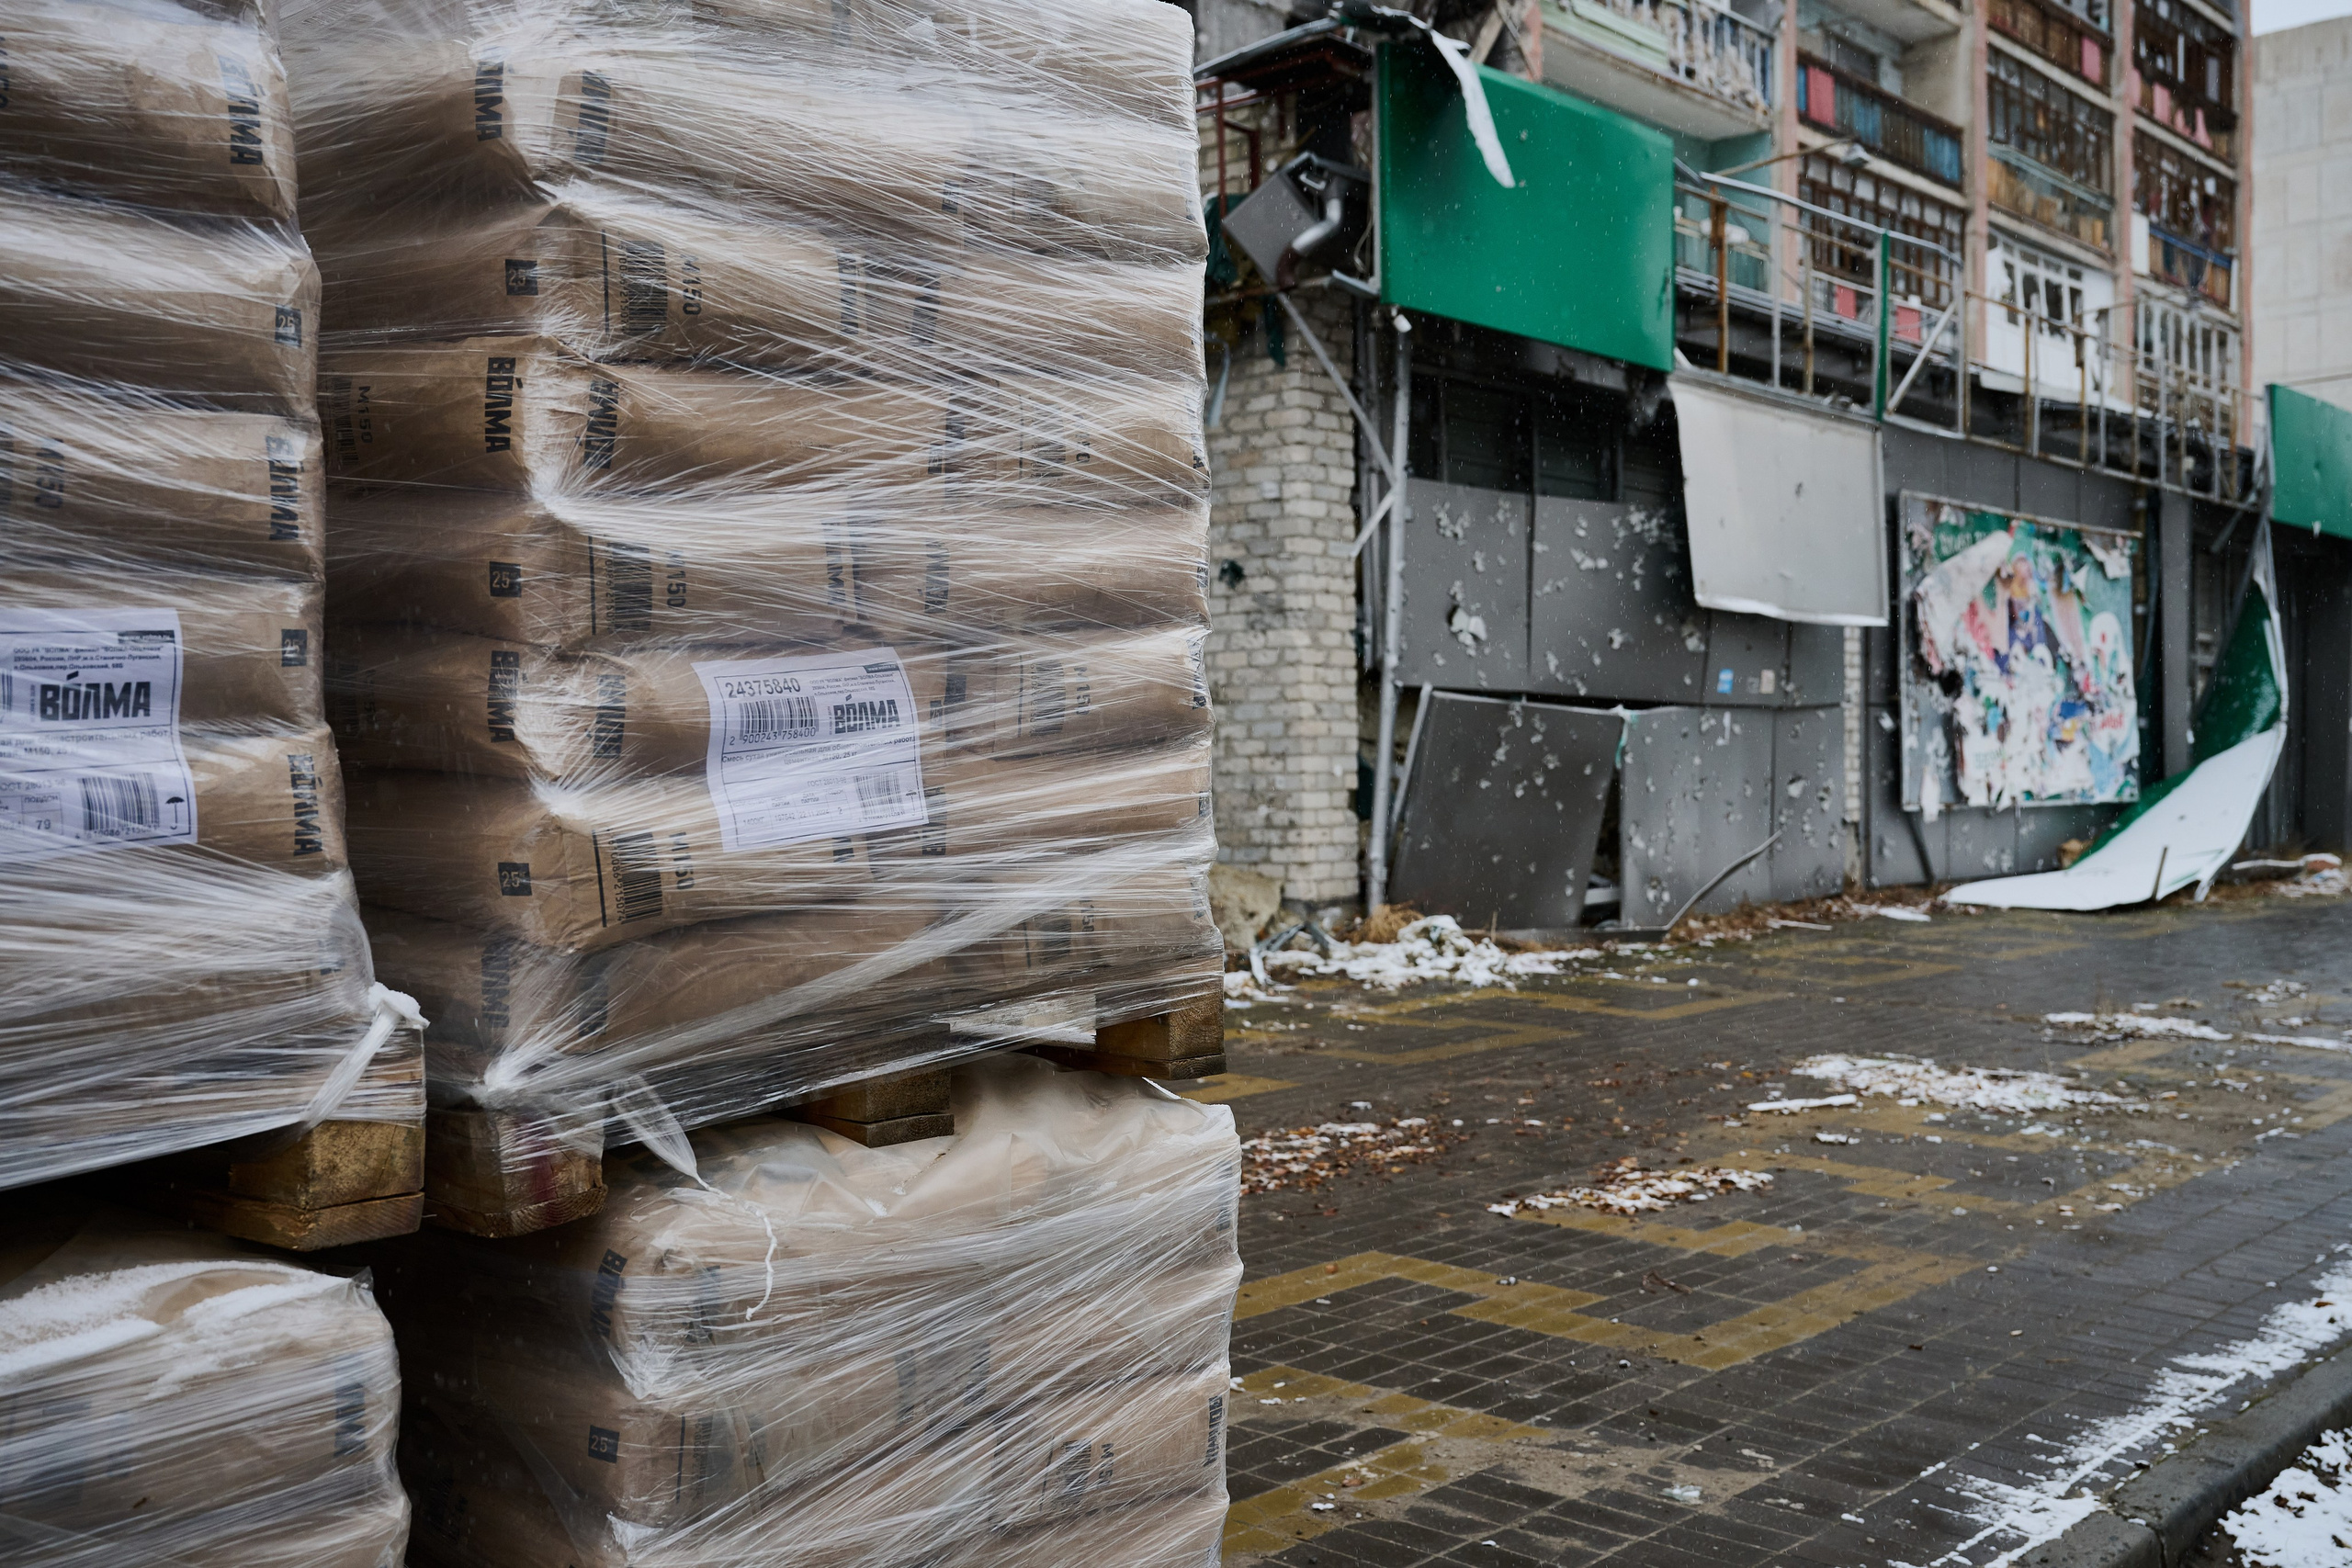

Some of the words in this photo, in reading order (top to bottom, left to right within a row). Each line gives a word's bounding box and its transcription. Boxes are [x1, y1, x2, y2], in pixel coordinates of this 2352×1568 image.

[492, 570, 510, 589] 25
[725, 677, 801, 698] 24375840
[729, 735, 736, 746] 2
[742, 732, 777, 744] 900243
[781, 727, 816, 739] 758400
[501, 871, 521, 888] 25
[590, 1434, 609, 1453] 25
